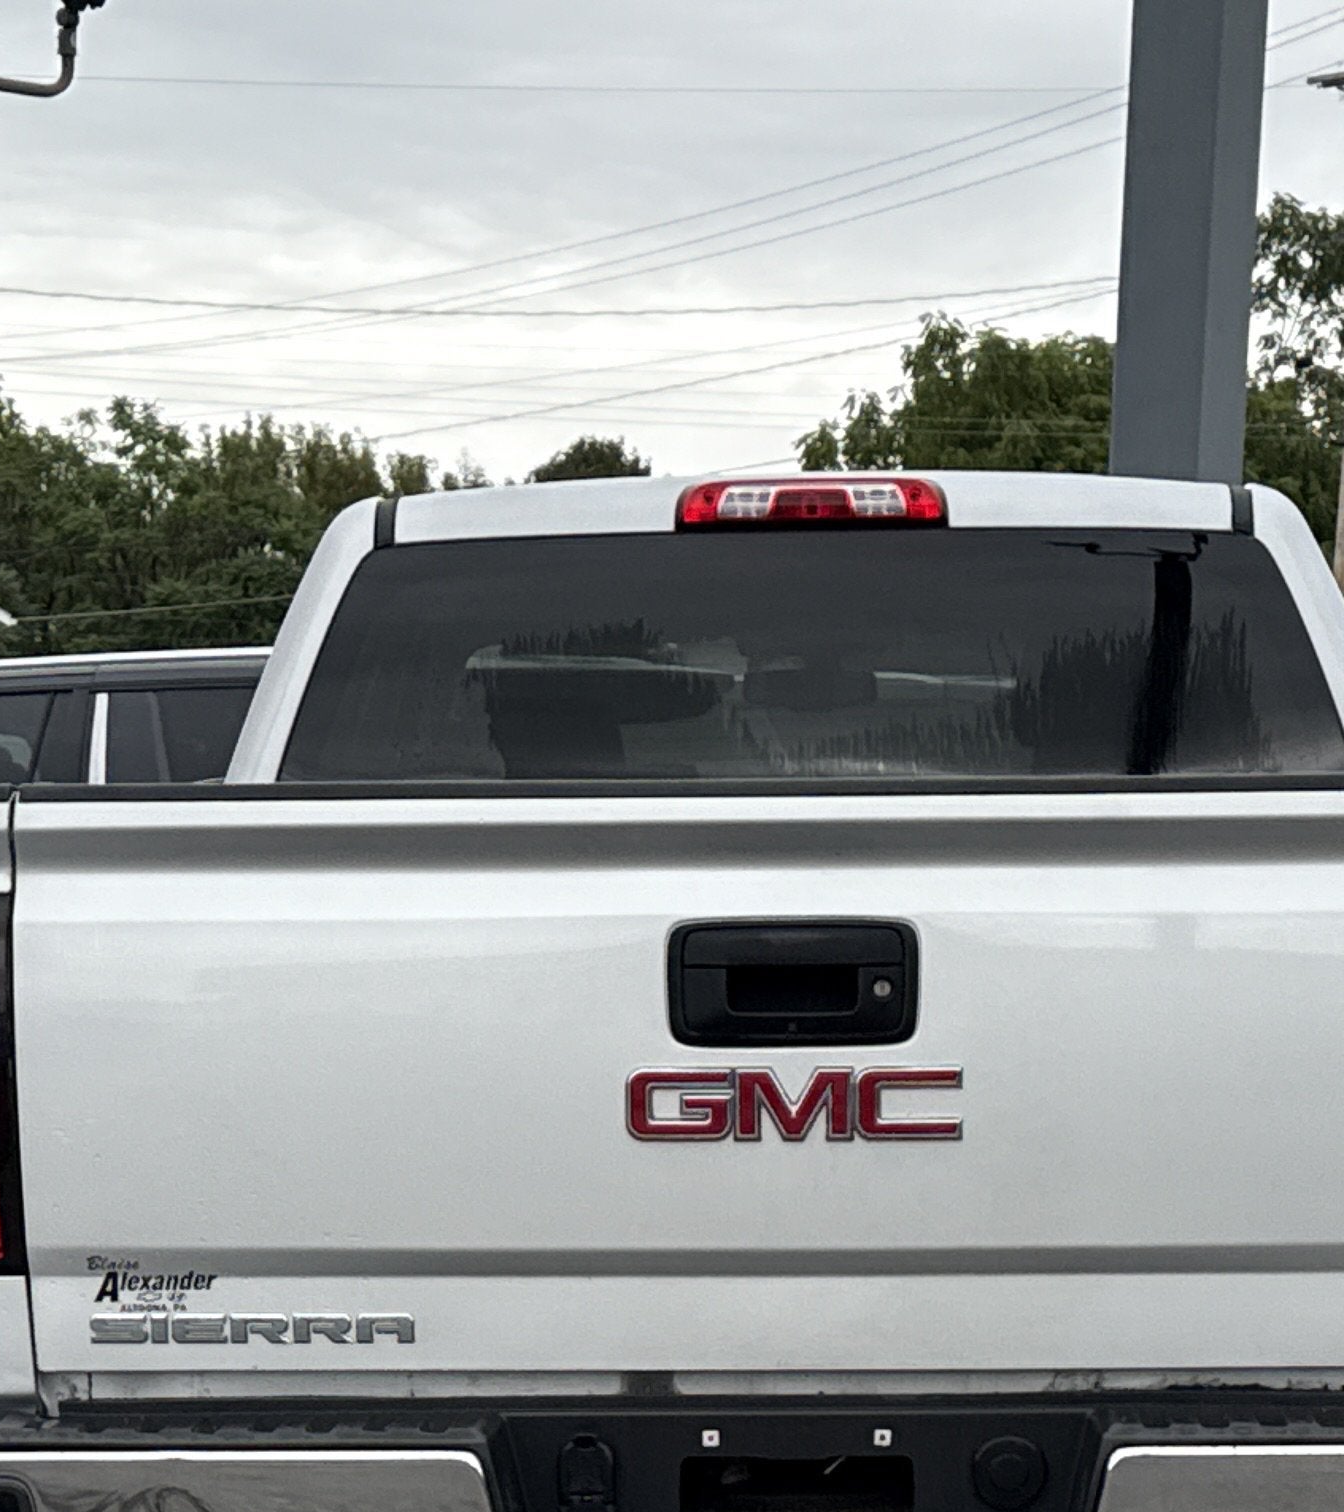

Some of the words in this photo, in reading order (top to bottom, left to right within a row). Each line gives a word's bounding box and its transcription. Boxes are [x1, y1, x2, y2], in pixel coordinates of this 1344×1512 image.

[624, 1064, 964, 1143] GMC
[86, 1255, 140, 1271] Blaise
[94, 1269, 219, 1303] Alexander
[90, 1311, 416, 1345] SIERRA
